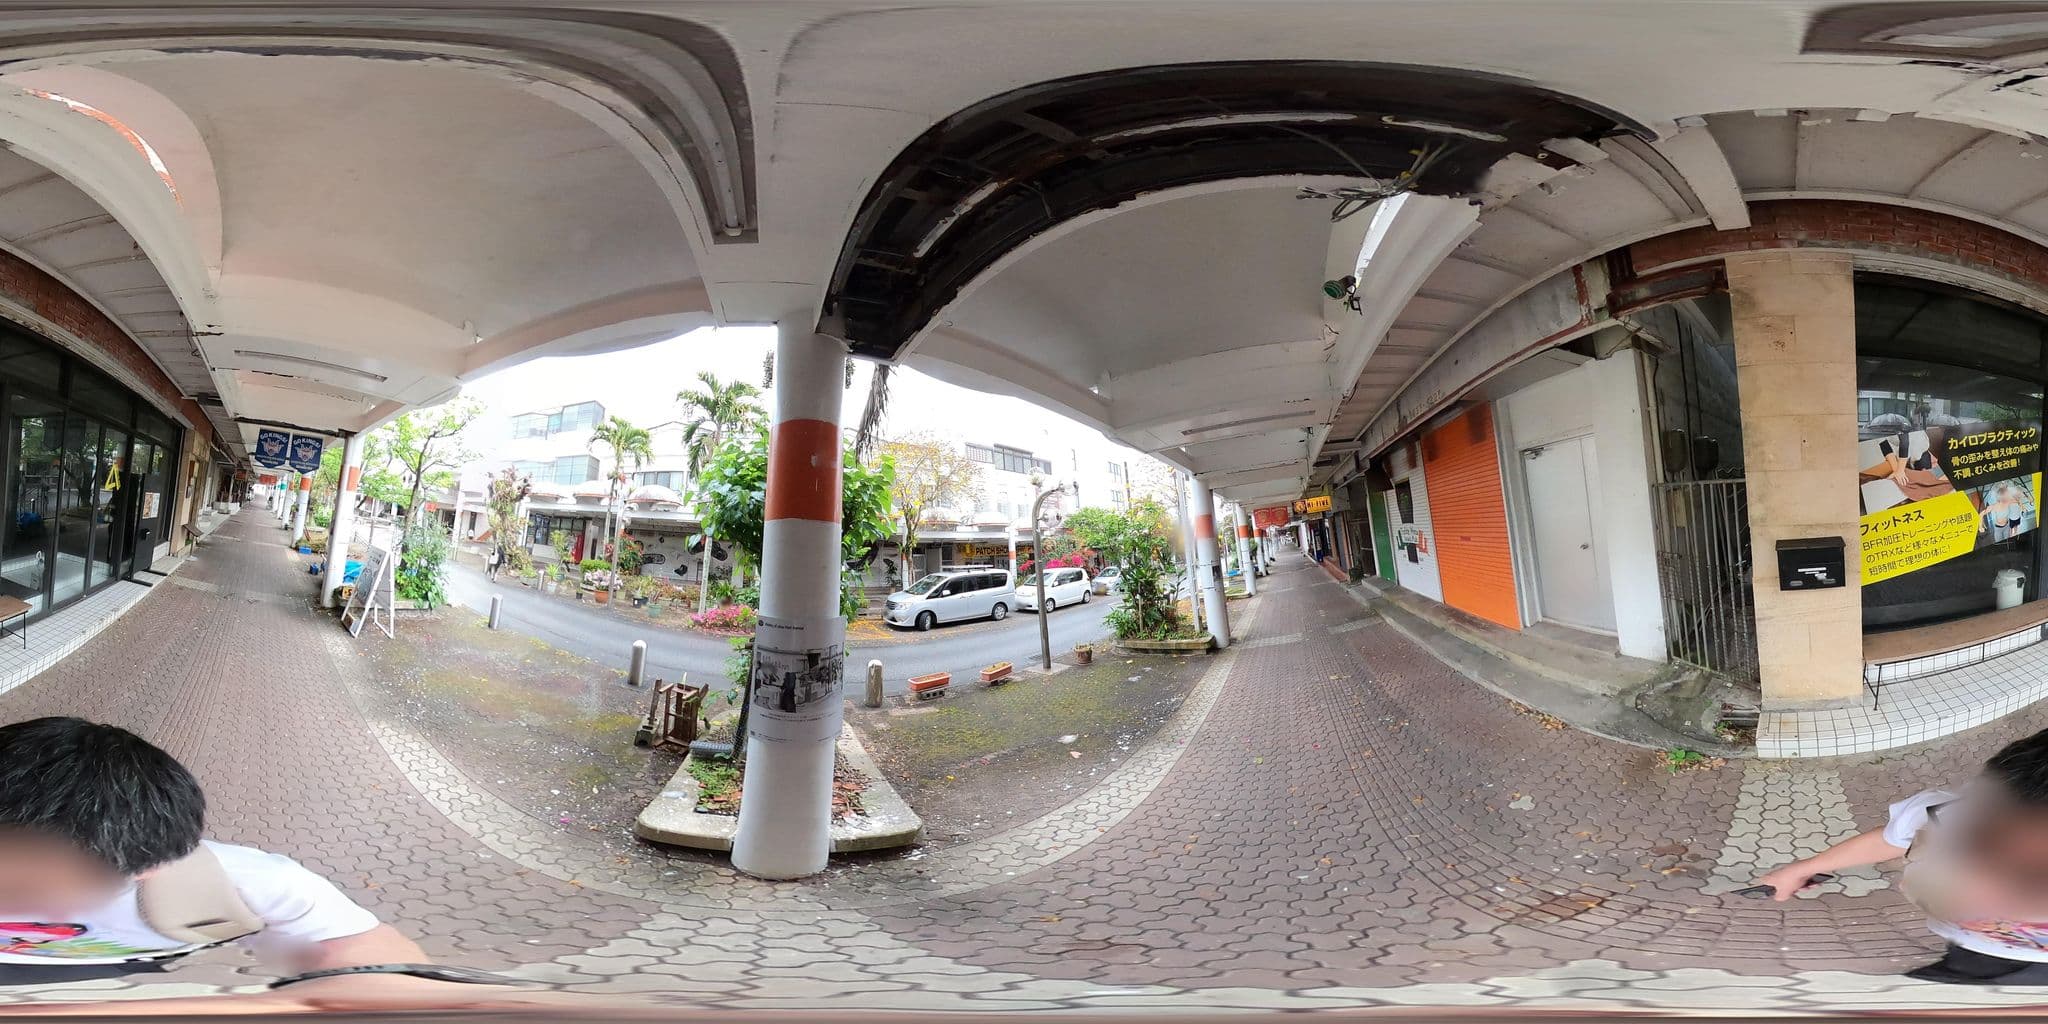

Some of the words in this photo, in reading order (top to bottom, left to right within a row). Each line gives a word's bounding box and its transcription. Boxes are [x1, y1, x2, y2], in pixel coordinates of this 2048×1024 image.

[1948, 427, 2036, 450] カイロプラクティック
[1860, 510, 1924, 536] フィットネス
[975, 545, 994, 556] PATCH
